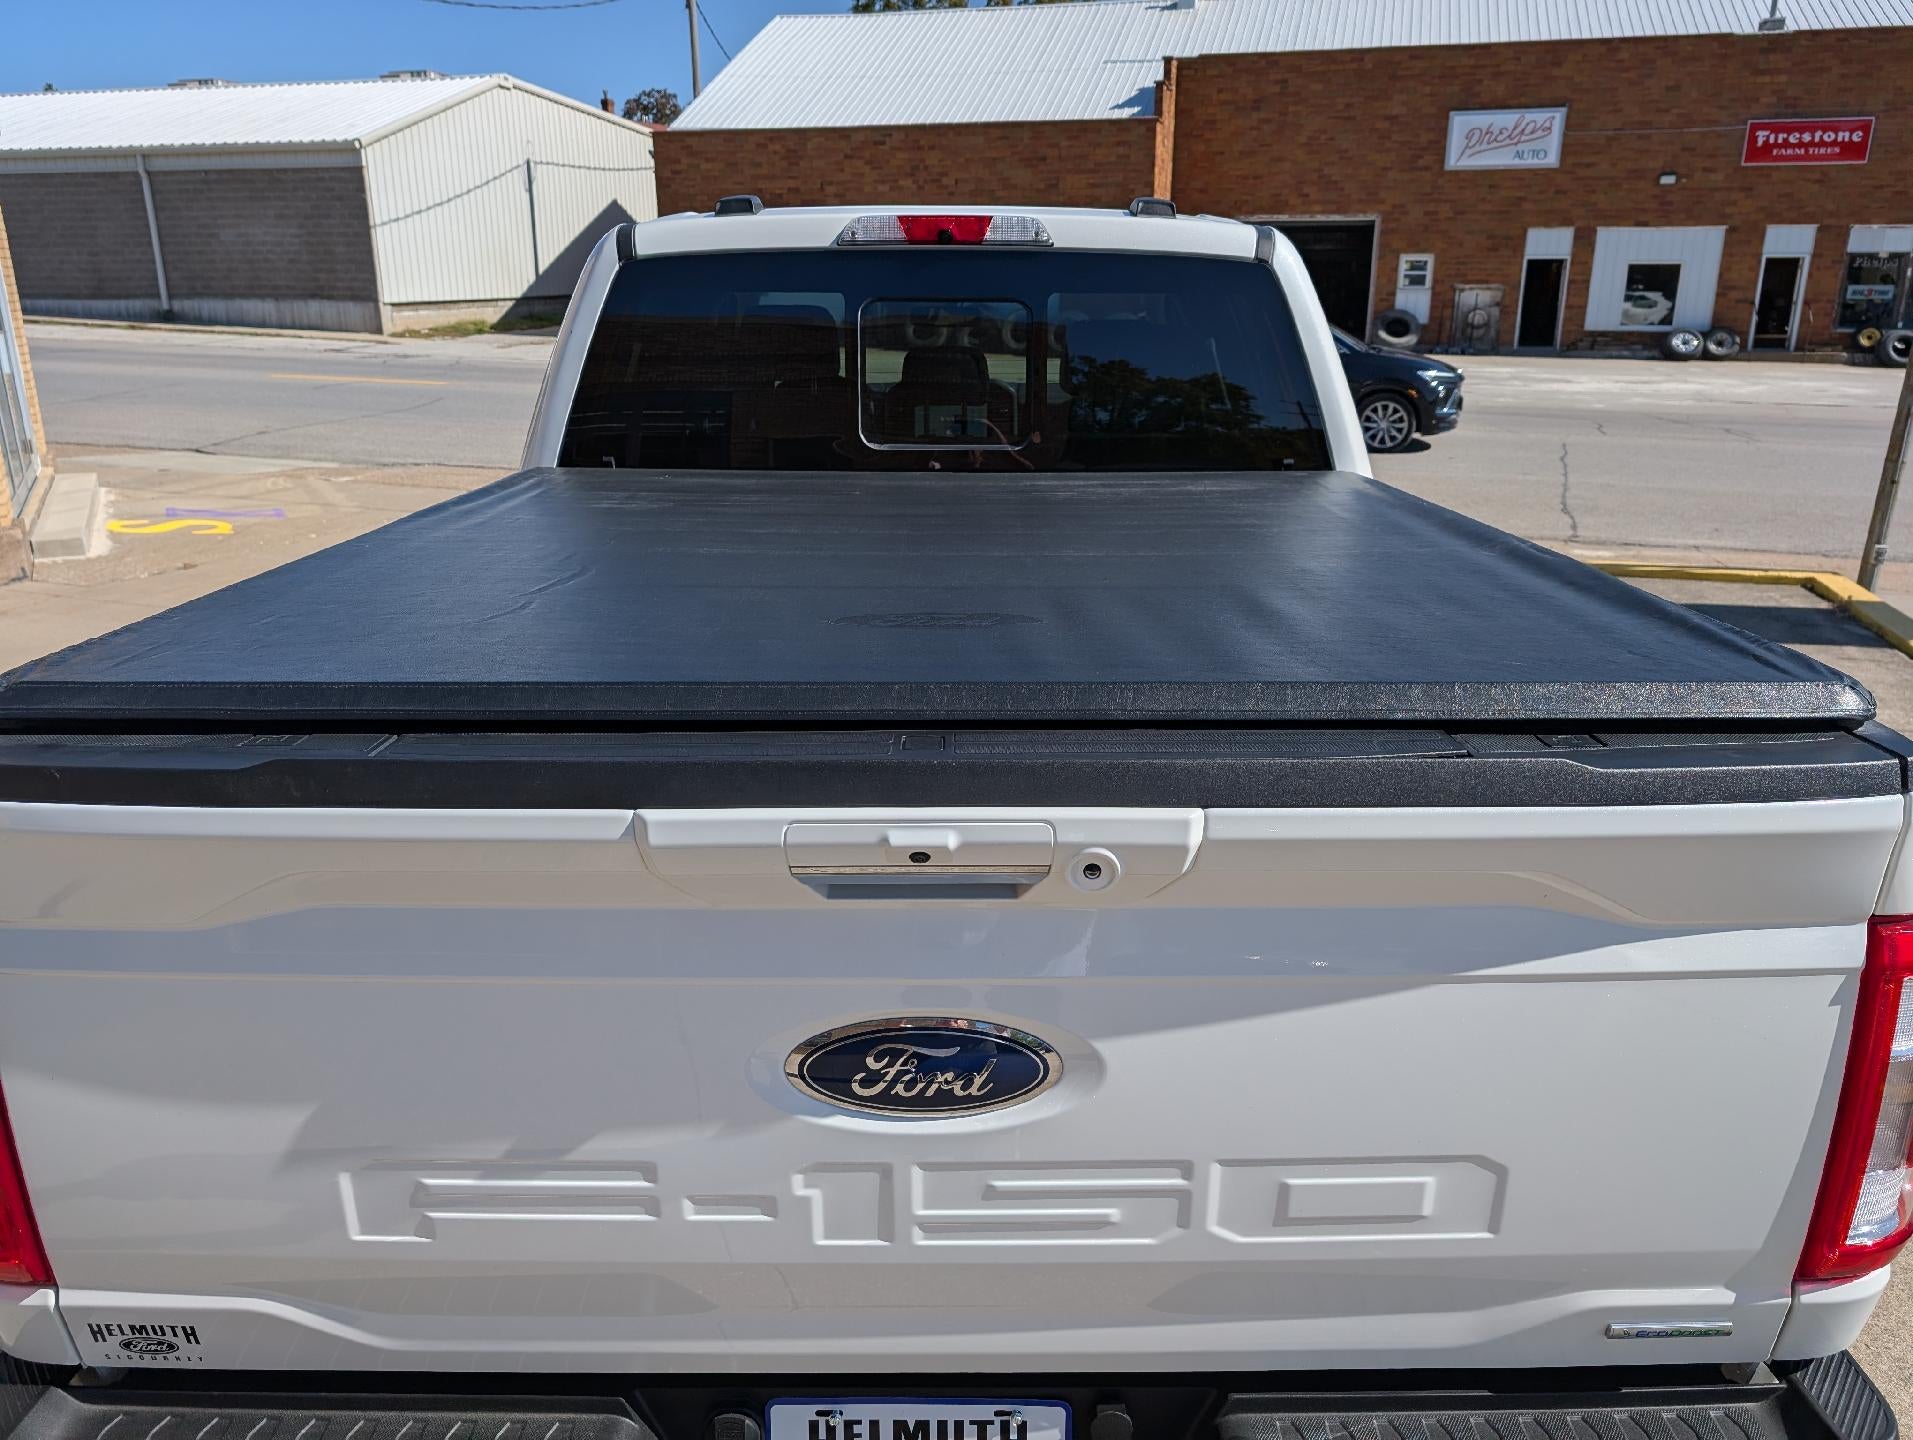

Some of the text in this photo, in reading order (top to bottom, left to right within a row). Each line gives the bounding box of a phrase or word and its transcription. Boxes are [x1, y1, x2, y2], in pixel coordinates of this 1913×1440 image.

[1755, 129, 1863, 147] Firestone
[1512, 149, 1548, 161] AUTO
[1808, 146, 1840, 154] TIRES
[851, 1043, 997, 1097] Ford
[337, 1157, 1508, 1246] F-150
[87, 1323, 202, 1345] HELMUTH
[129, 1339, 169, 1351] Ford
